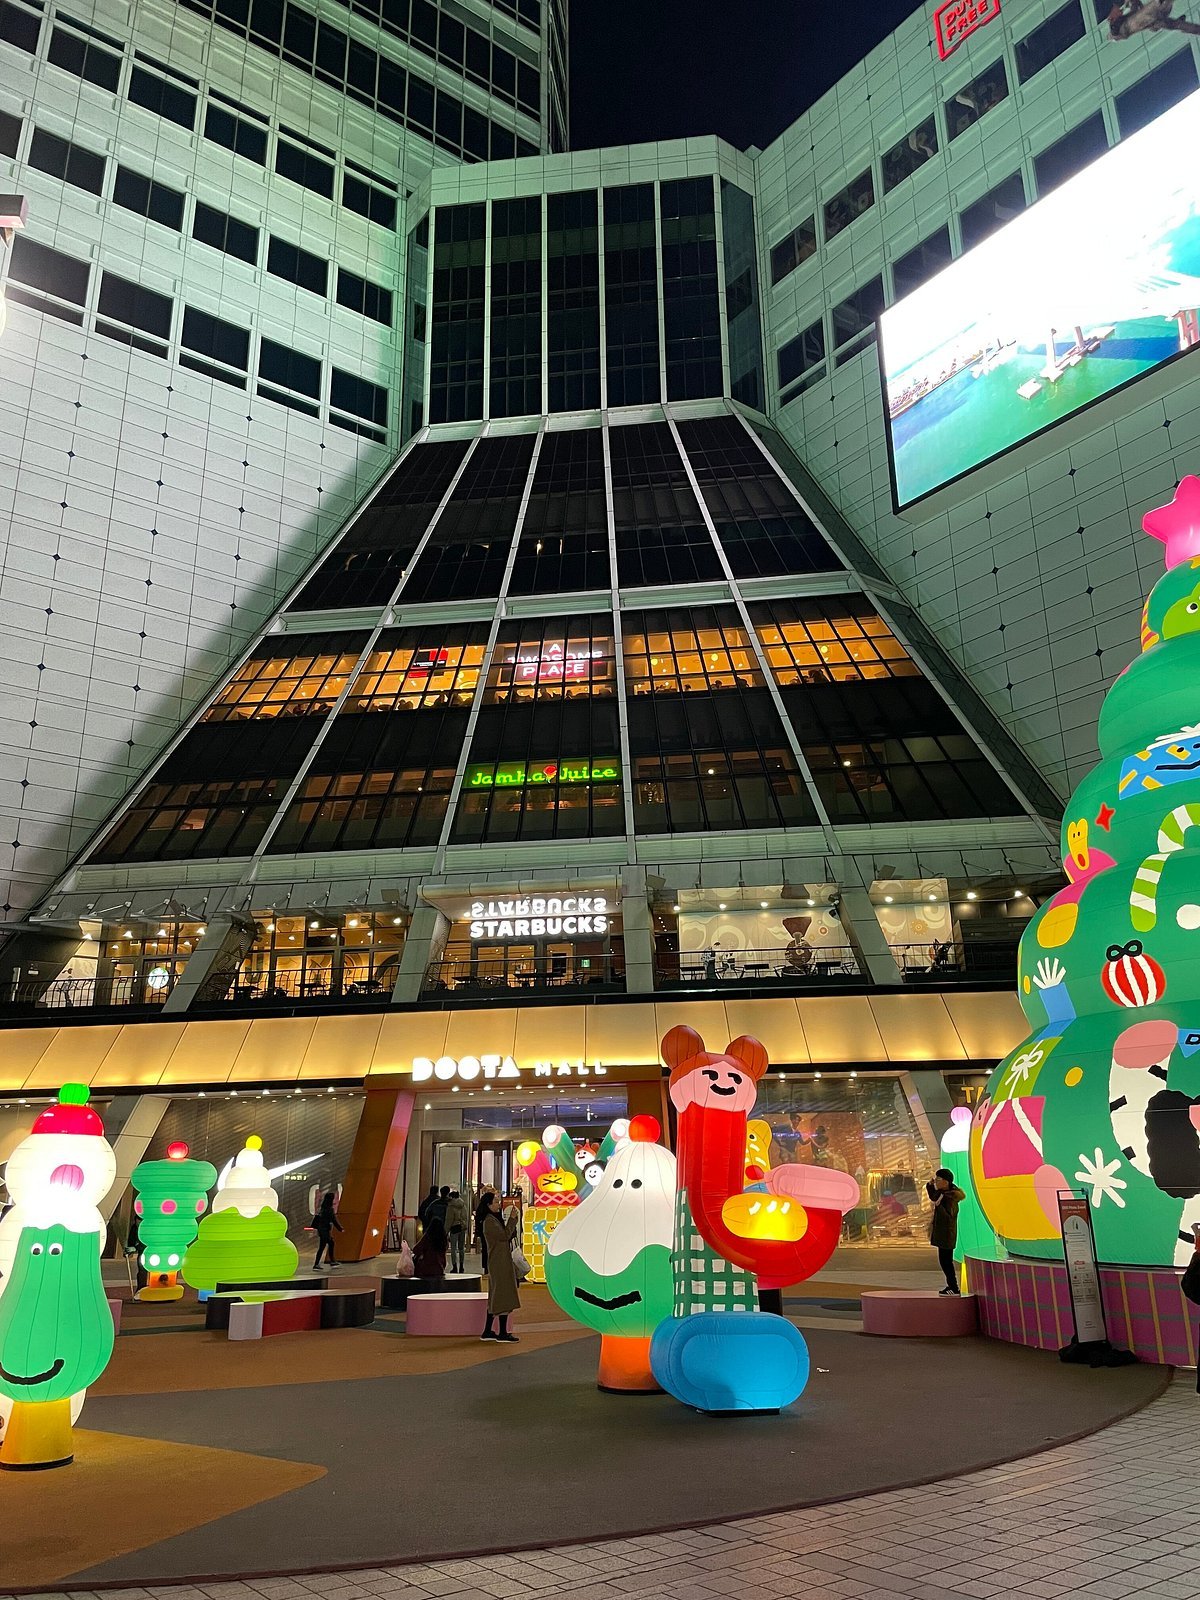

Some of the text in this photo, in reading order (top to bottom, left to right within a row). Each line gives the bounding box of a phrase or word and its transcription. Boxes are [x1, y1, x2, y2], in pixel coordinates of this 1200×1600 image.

[946, 0, 988, 41] FREE
[549, 643, 562, 653] A
[522, 662, 585, 677] PLACE
[471, 766, 618, 785] Jamba Juice
[469, 915, 608, 938] STARBUCKS
[412, 1054, 607, 1081] DOOTA MALL
